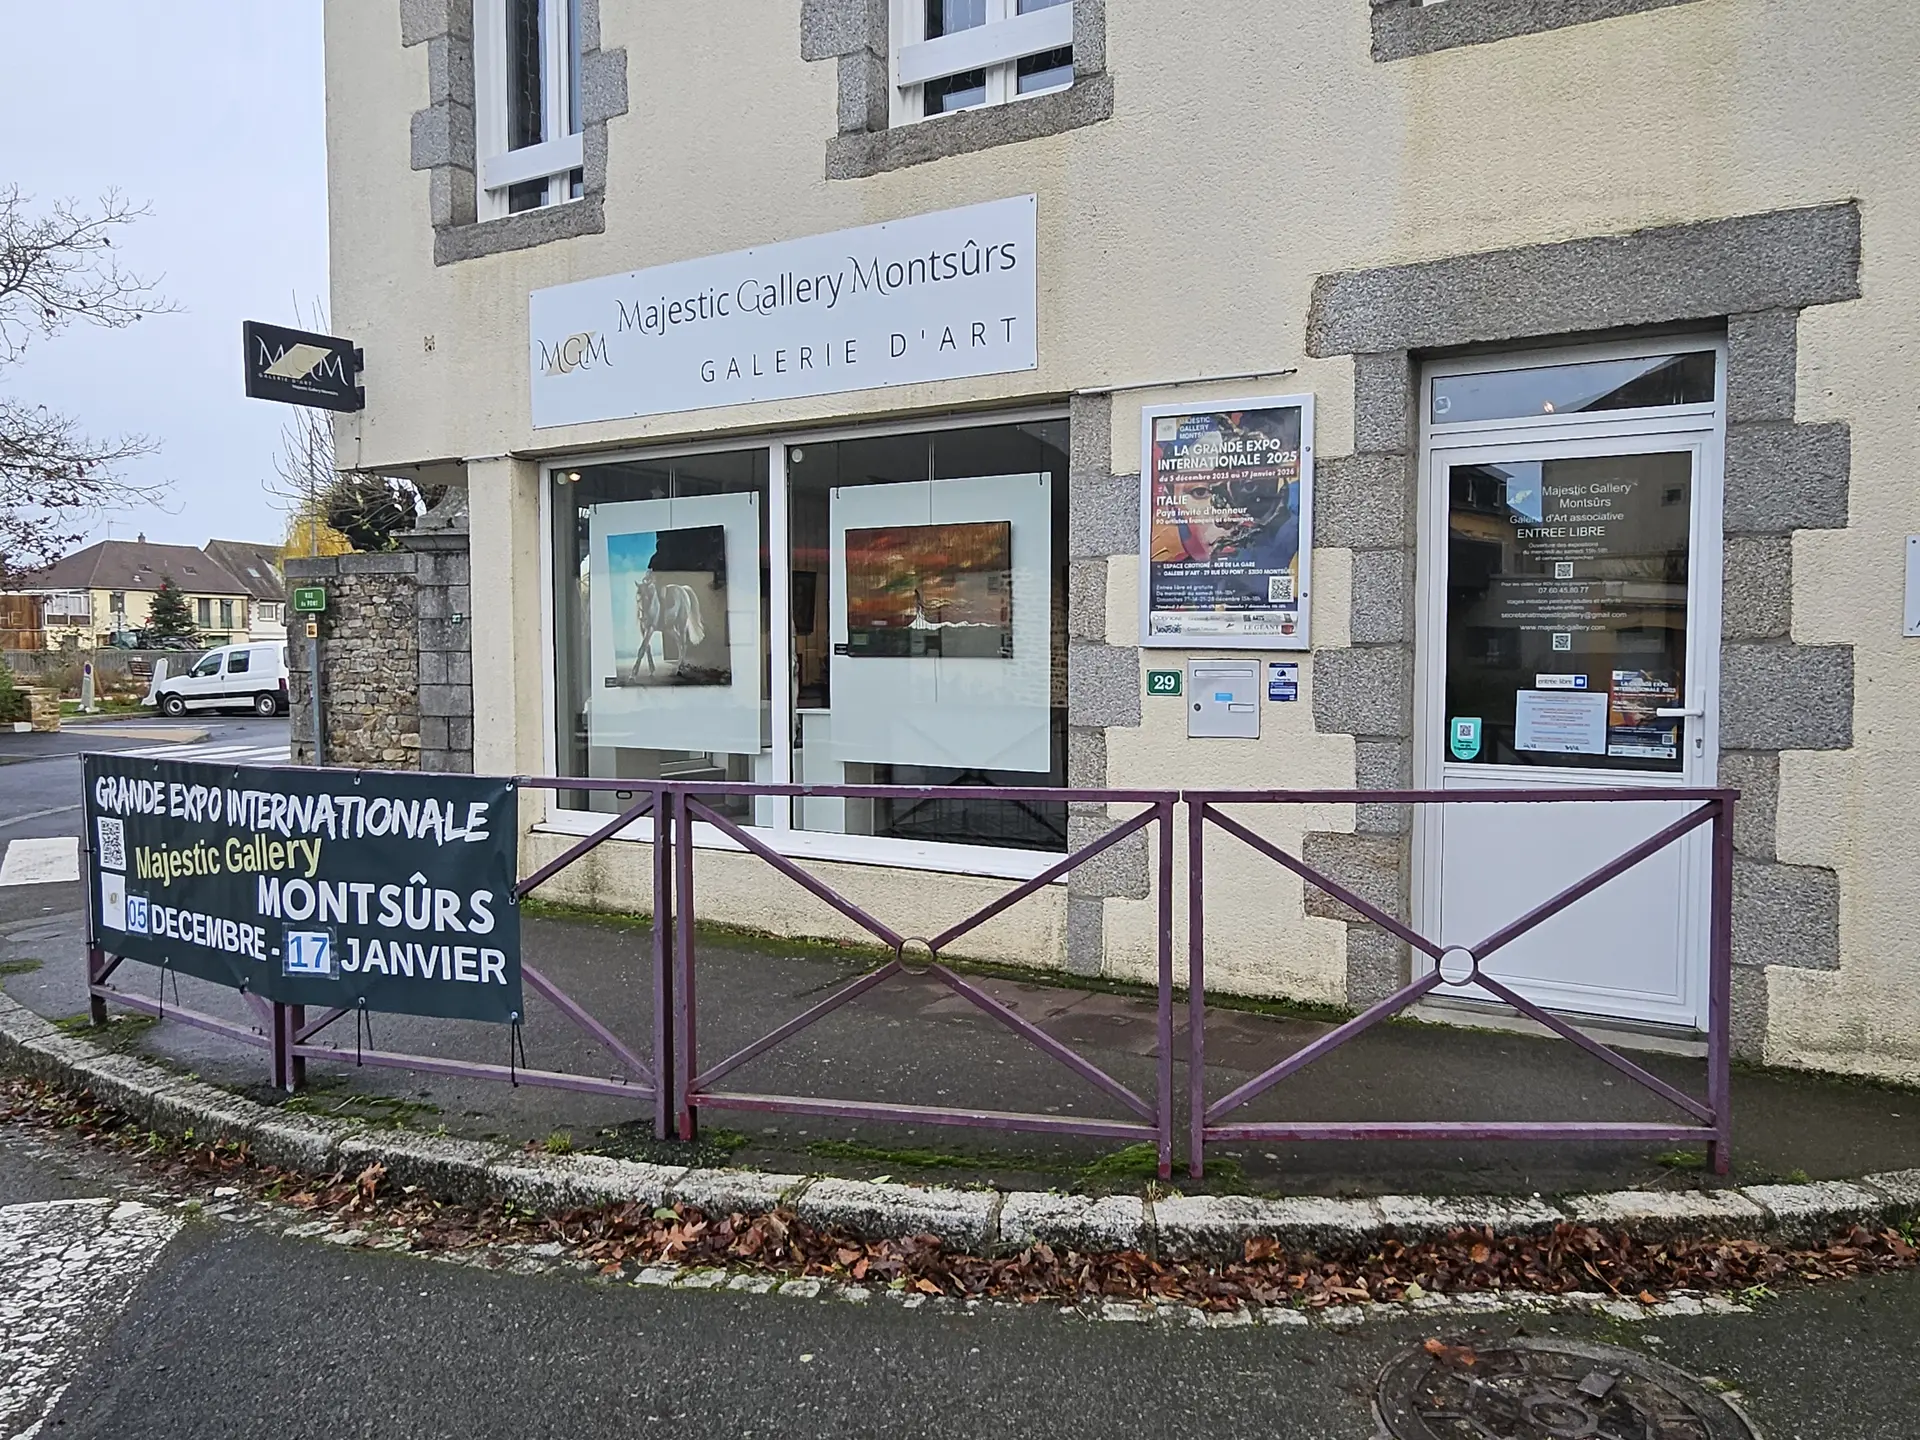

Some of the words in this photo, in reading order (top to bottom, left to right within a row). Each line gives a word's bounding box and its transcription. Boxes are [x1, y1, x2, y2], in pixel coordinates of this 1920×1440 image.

[615, 288, 729, 336] Majestic
[737, 269, 844, 315] Gallery
[848, 240, 1017, 296] Montsûrs
[537, 332, 613, 373] MGM
[701, 338, 858, 383] GALERIE
[890, 317, 1017, 359] D'ART
[1180, 424, 1209, 432] GALLERY
[1174, 445, 1189, 456] LA
[1193, 440, 1243, 455] GRANDE
[1246, 439, 1281, 451] EXPO
[1158, 452, 1260, 471] INTERNATIONALE
[1267, 451, 1297, 464] 2025
[1175, 472, 1211, 481] décembre
[1250, 470, 1276, 479] janvier
[1542, 485, 1587, 497] Majestic
[1590, 483, 1632, 495] Gallery
[1156, 495, 1188, 506] ITALIE
[1559, 497, 1612, 508] Montsûrs
[1546, 514, 1567, 522] d'Art
[1570, 511, 1624, 522] associative
[1517, 527, 1566, 538] ENTREE
[1570, 526, 1605, 537] LIBRE
[1153, 674, 1175, 690] 29
[1559, 677, 1572, 685] libre
[96, 776, 166, 814] GRANDE
[170, 783, 222, 823] EXPO
[227, 787, 490, 847] INTERNATIONALE
[135, 843, 220, 887] Majestic
[225, 833, 322, 878] Gallery
[258, 871, 495, 934] MONTSÛRS
[128, 903, 147, 929] 05
[152, 903, 268, 961] DECEMBRE
[289, 936, 329, 969] 17
[341, 938, 507, 985] JANVIER
